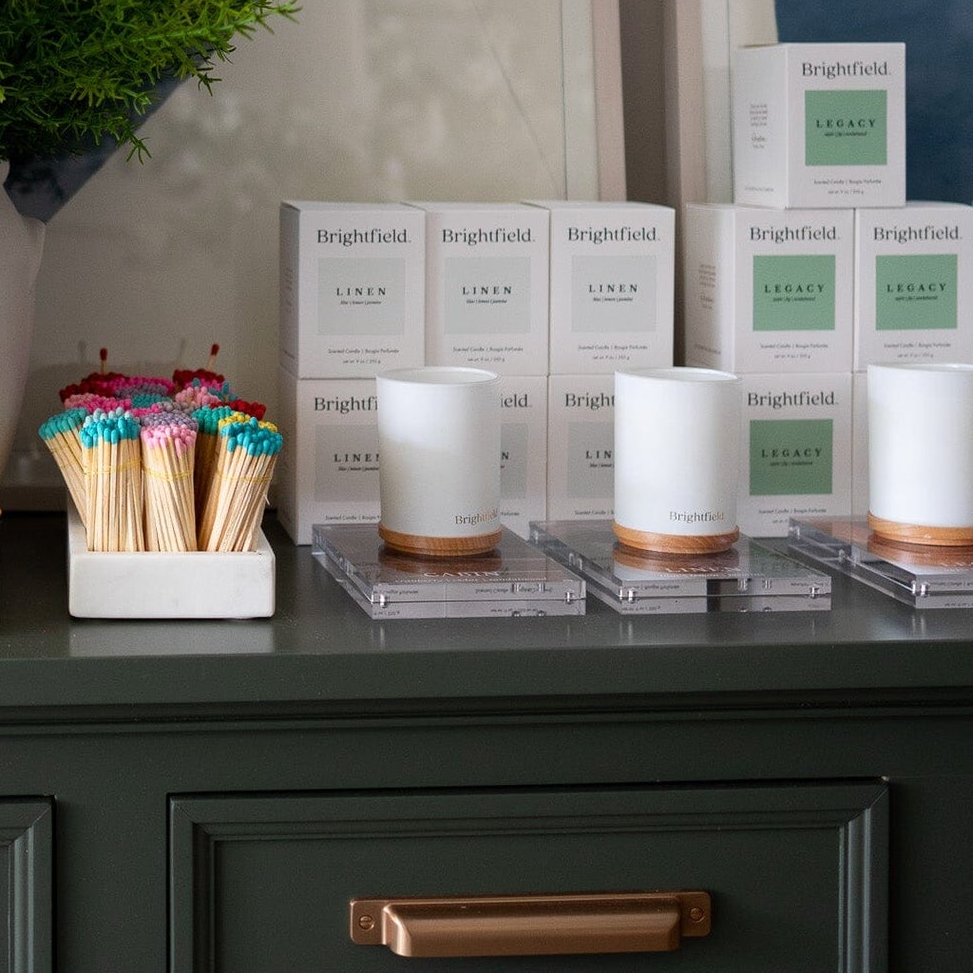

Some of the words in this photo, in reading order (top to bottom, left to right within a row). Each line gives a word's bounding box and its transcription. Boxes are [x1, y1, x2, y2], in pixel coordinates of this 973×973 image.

[815, 119, 876, 128] LEGACY
[336, 287, 386, 296] LINEN
[462, 286, 512, 295] LINEN
[588, 284, 638, 293] LINEN
[764, 284, 825, 293] LEGACY
[887, 283, 946, 292] LEGACY
[314, 396, 378, 415] Brightfi
[565, 393, 615, 411] Bright
[585, 450, 612, 459] LIN
[761, 448, 822, 458] LEGACY
